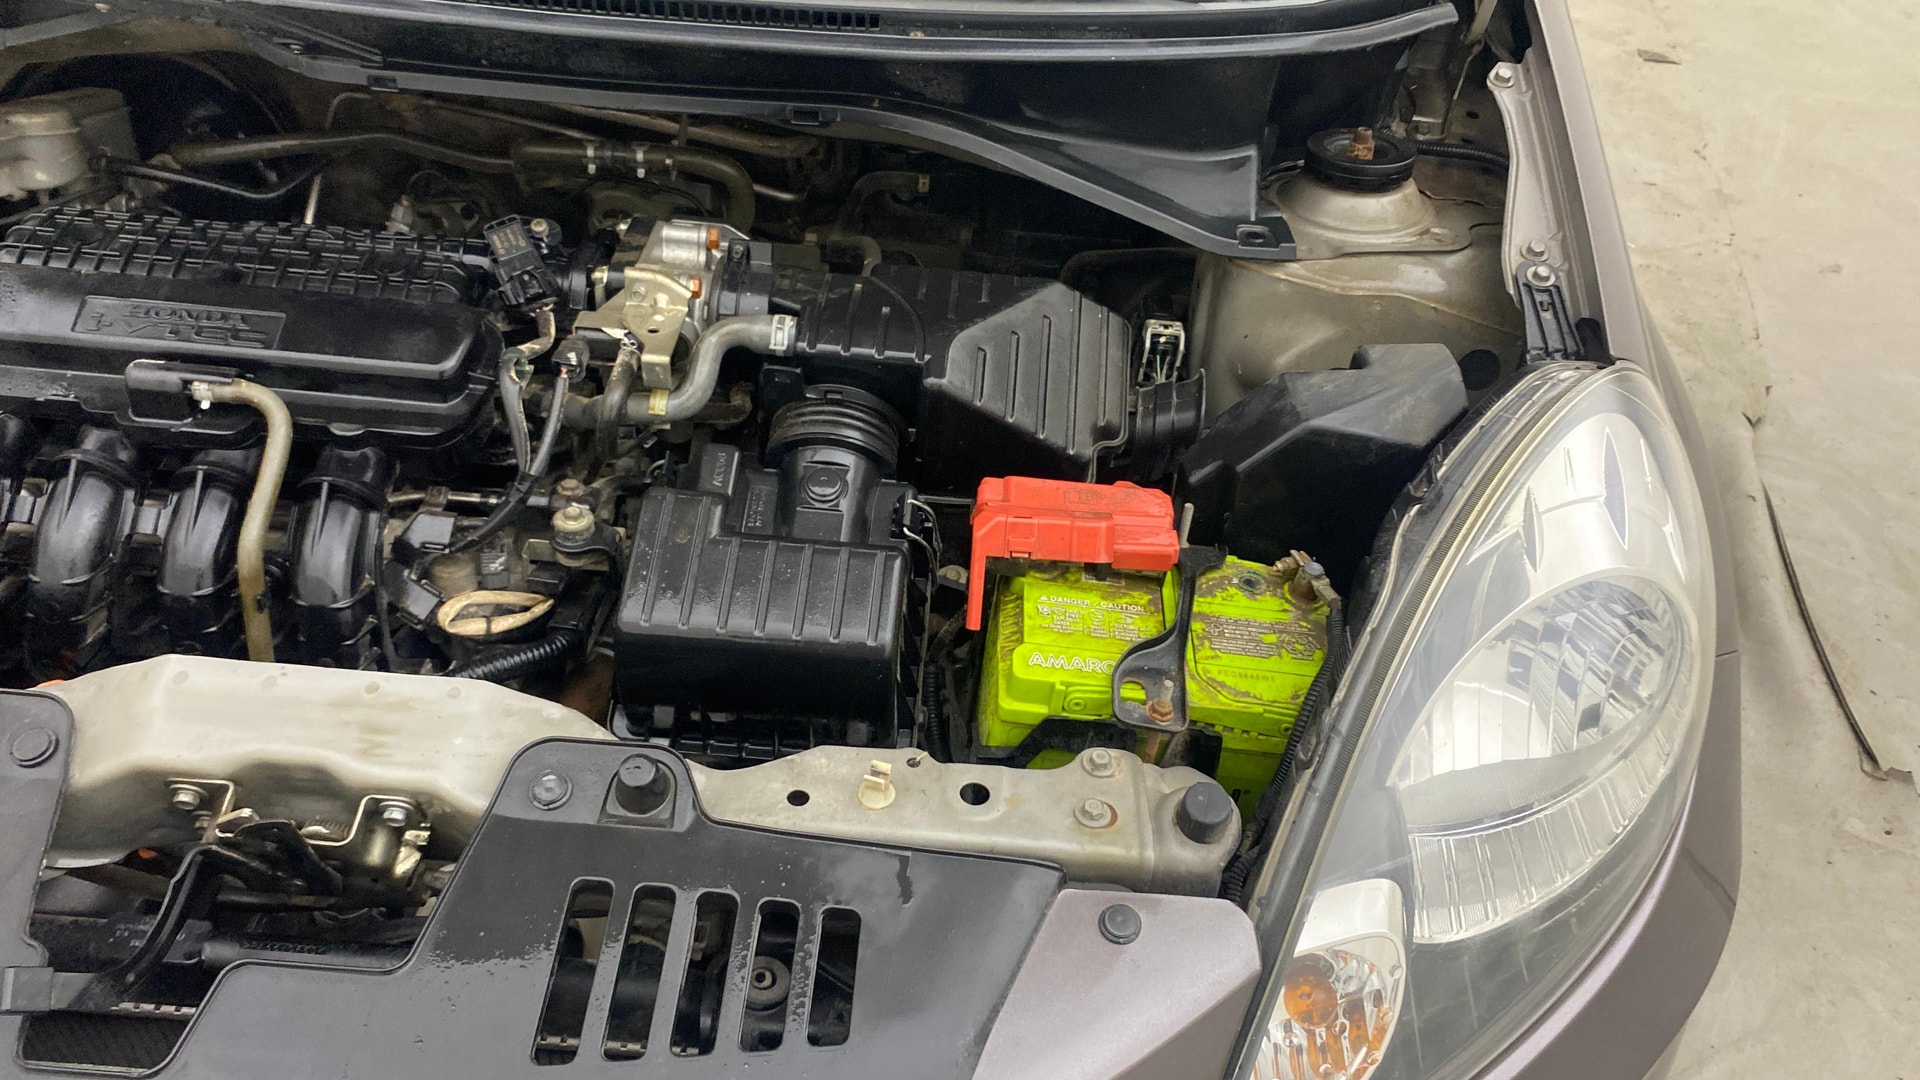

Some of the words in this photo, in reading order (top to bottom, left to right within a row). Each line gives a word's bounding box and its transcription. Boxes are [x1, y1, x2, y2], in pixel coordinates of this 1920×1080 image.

[122, 304, 250, 330] HONDA
[1050, 595, 1090, 606] DANGER
[1100, 601, 1144, 612] CAUTION
[1028, 652, 1116, 675] AMARO
